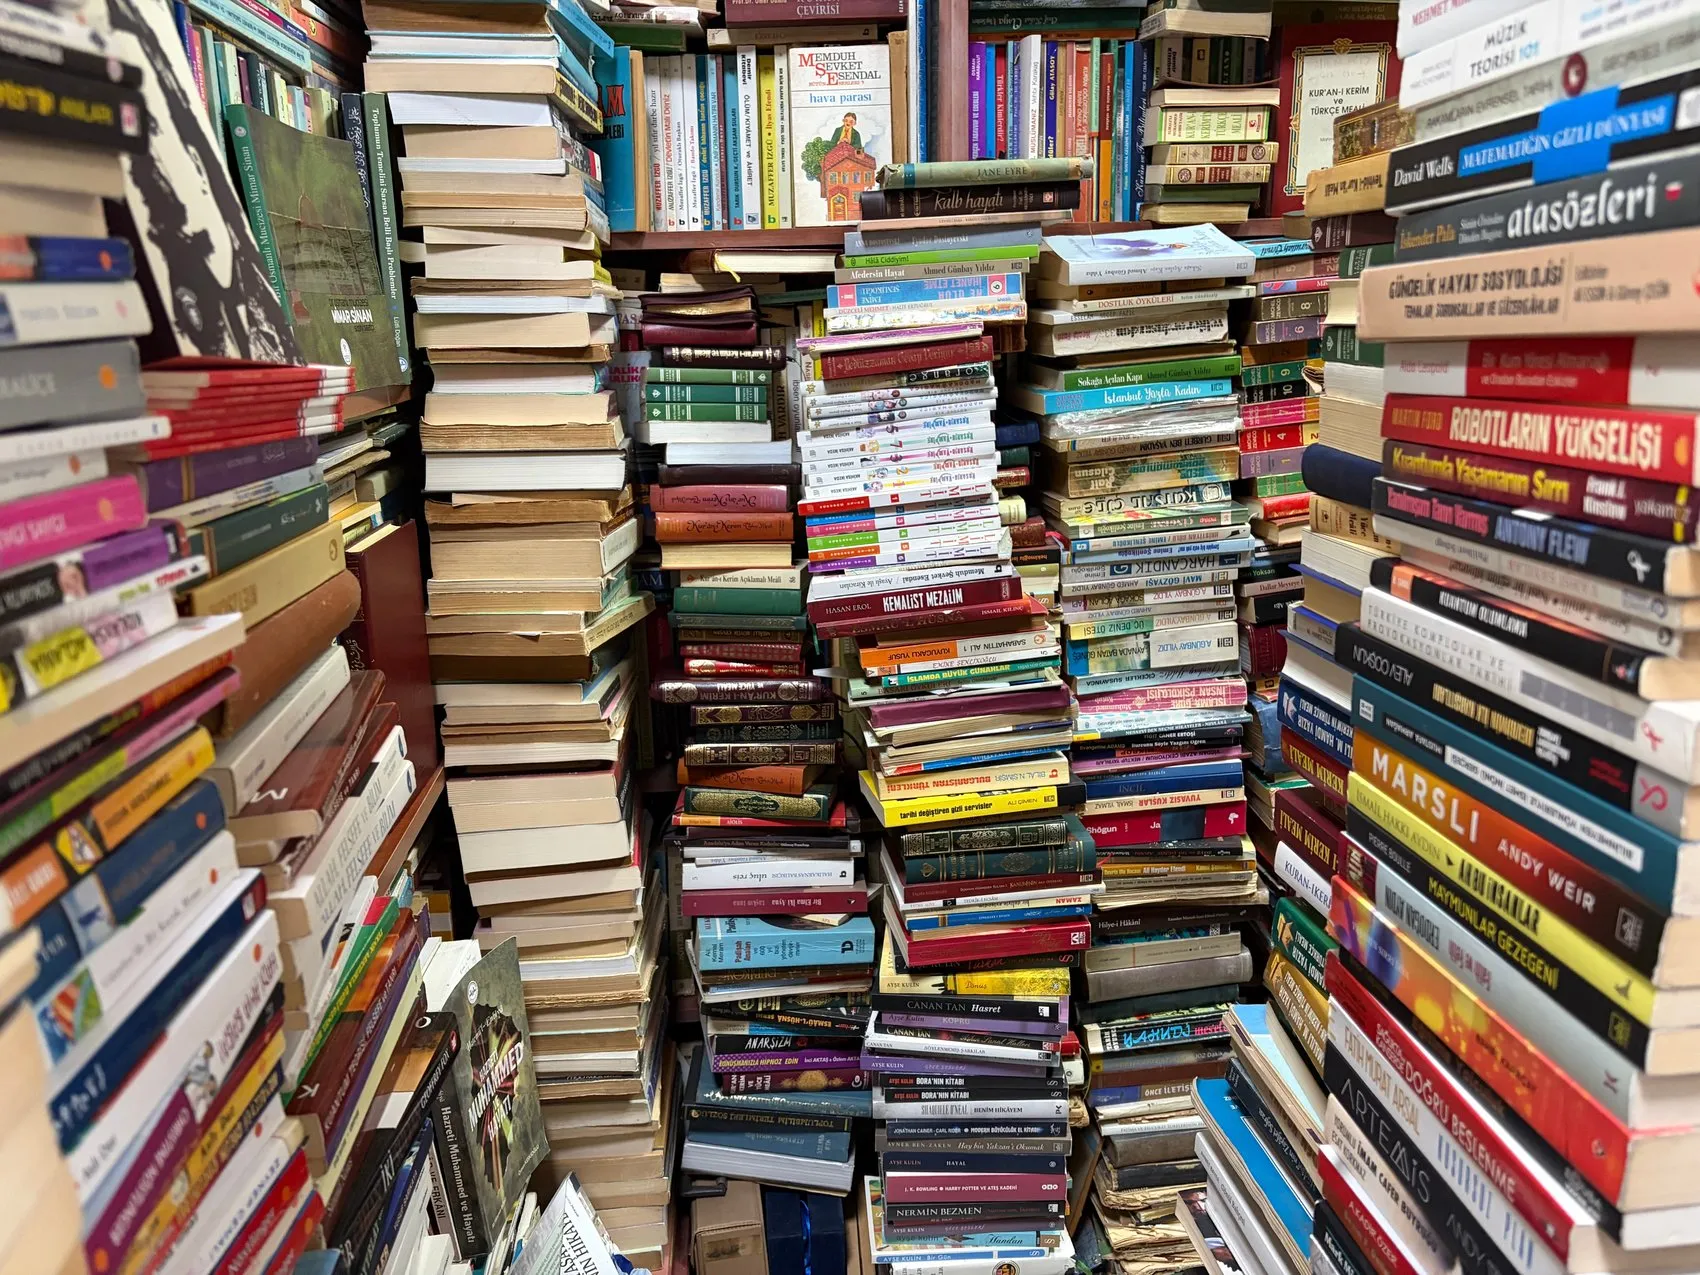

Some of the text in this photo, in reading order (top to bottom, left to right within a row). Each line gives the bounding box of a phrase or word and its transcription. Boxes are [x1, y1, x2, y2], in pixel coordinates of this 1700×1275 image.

[796, 4, 841, 18] ÇEVİRİSİ
[1483, 20, 1528, 49] MÜZİK
[798, 51, 856, 68] MEMDUH
[1469, 51, 1516, 79] TEORİSİ
[826, 70, 882, 87] ESENDAL
[809, 92, 873, 105] hava parası
[1309, 86, 1370, 98] KUR'AN-I KERİM
[996, 74, 1004, 142] Türkler Kimlerdir?
[1310, 105, 1340, 116] TÜRKÇE
[1231, 113, 1242, 134] MEALİ
[765, 139, 774, 160] İZGÜ
[976, 166, 1028, 178] JANE EYRE
[1393, 166, 1425, 187] David
[1424, 156, 1455, 180] Wells
[766, 162, 775, 207] MUZAFFER
[371, 106, 398, 300] Toplumun Temelini Sarsan Problemler
[933, 188, 1003, 212] kalb hayatı
[1506, 171, 1658, 239] atasözleri
[241, 145, 279, 286] Osmanlı Mimar Sinan
[880, 255, 910, 265] Ciddiyim!
[923, 263, 996, 276] Ahmed Günbay Yıldız
[850, 268, 905, 279] Afedersin Hayat
[1126, 266, 1148, 276] Ahmed
[1388, 275, 1437, 299] GÜNDELİK
[1439, 272, 1479, 296] HAYAT
[1480, 257, 1565, 293] SOSYOLOJİSİ
[1098, 295, 1174, 309] DOSTLUK ÖYKÜLERİ
[351, 307, 373, 324] SİNAN
[1077, 372, 1143, 387] Sokağa Açılan Kapı
[792, 378, 801, 404] ibsen
[1103, 385, 1201, 405] İstanbul Kadın
[777, 383, 787, 432] VARDIR
[1139, 439, 1169, 452] YAŞADIM
[1449, 405, 1551, 455] ROBOTLARIN
[1553, 415, 1663, 472] YÜKSELİŞİ
[1152, 547, 1173, 556] Emine
[1135, 554, 1216, 574] HARCANDIK
[902, 567, 985, 584] Memduh Şevket Esendal
[1071, 574, 1203, 593] MAVİ GÖZYAŞI AHMED YILDIZ
[1084, 571, 1106, 579] Emine
[826, 603, 872, 615] HASAN EROL
[883, 588, 963, 613] KEMALİST MEZALİM
[1083, 619, 1145, 636] ÜÇ DENİZ ÖTESİ
[887, 638, 1027, 661] SABAHATTİN ALİ KUYUCAKLI YUSUF
[1098, 639, 1212, 660] A.GÜNBAY YILDIZ AYNADA BATAN
[1351, 644, 1390, 675] COŞKUN
[907, 663, 1011, 684] İSLAMDA BÜYÜK GÜNAHLAR
[1085, 672, 1156, 686] ÇİÇEKLER SUSAYINCA
[1389, 663, 1414, 687] ALEV
[1289, 744, 1345, 796] KERİM MEALİ
[887, 775, 992, 794] BULGARİSTAN TÜRKLERİ
[1371, 746, 1481, 843] MARSLI
[900, 800, 993, 820] tarihi değiştiren gizli servisler
[1094, 793, 1201, 811] YUVASIZ KUŞLAR YILMAZ
[1383, 810, 1409, 839] HAKKI
[1410, 828, 1441, 861] AYDIN
[1303, 830, 1332, 863] KERİM
[1496, 837, 1597, 914] ANDY WEIR
[1428, 883, 1560, 991] MAYMUNLAR GEZEGENİ
[906, 1001, 1002, 1015] CANAN TAN Hasret
[744, 1035, 793, 1050] ANARŞİZM
[886, 1026, 932, 1039] CANAN TAN
[871, 1061, 905, 1070] AYŞE KULİN
[468, 1040, 524, 1132] MUHAMMED
[915, 1075, 965, 1087] BORA'NIN KİTABI
[921, 1089, 970, 1101] BORA'NIN KİTABI
[1144, 1086, 1163, 1097] ÖNCE
[1340, 1078, 1431, 1204] ARTEMİS
[1404, 1063, 1449, 1127] DOĞRU
[1451, 1115, 1516, 1203] BESLENME
[945, 1159, 967, 1167] HAYAL
[1356, 1137, 1401, 1208] İMAM CAFER
[441, 1105, 476, 1245] Hazreti Muhammed Hayatı
[895, 1206, 983, 1218] NERMİN BEZMEN
[985, 1233, 1024, 1247] Handan
